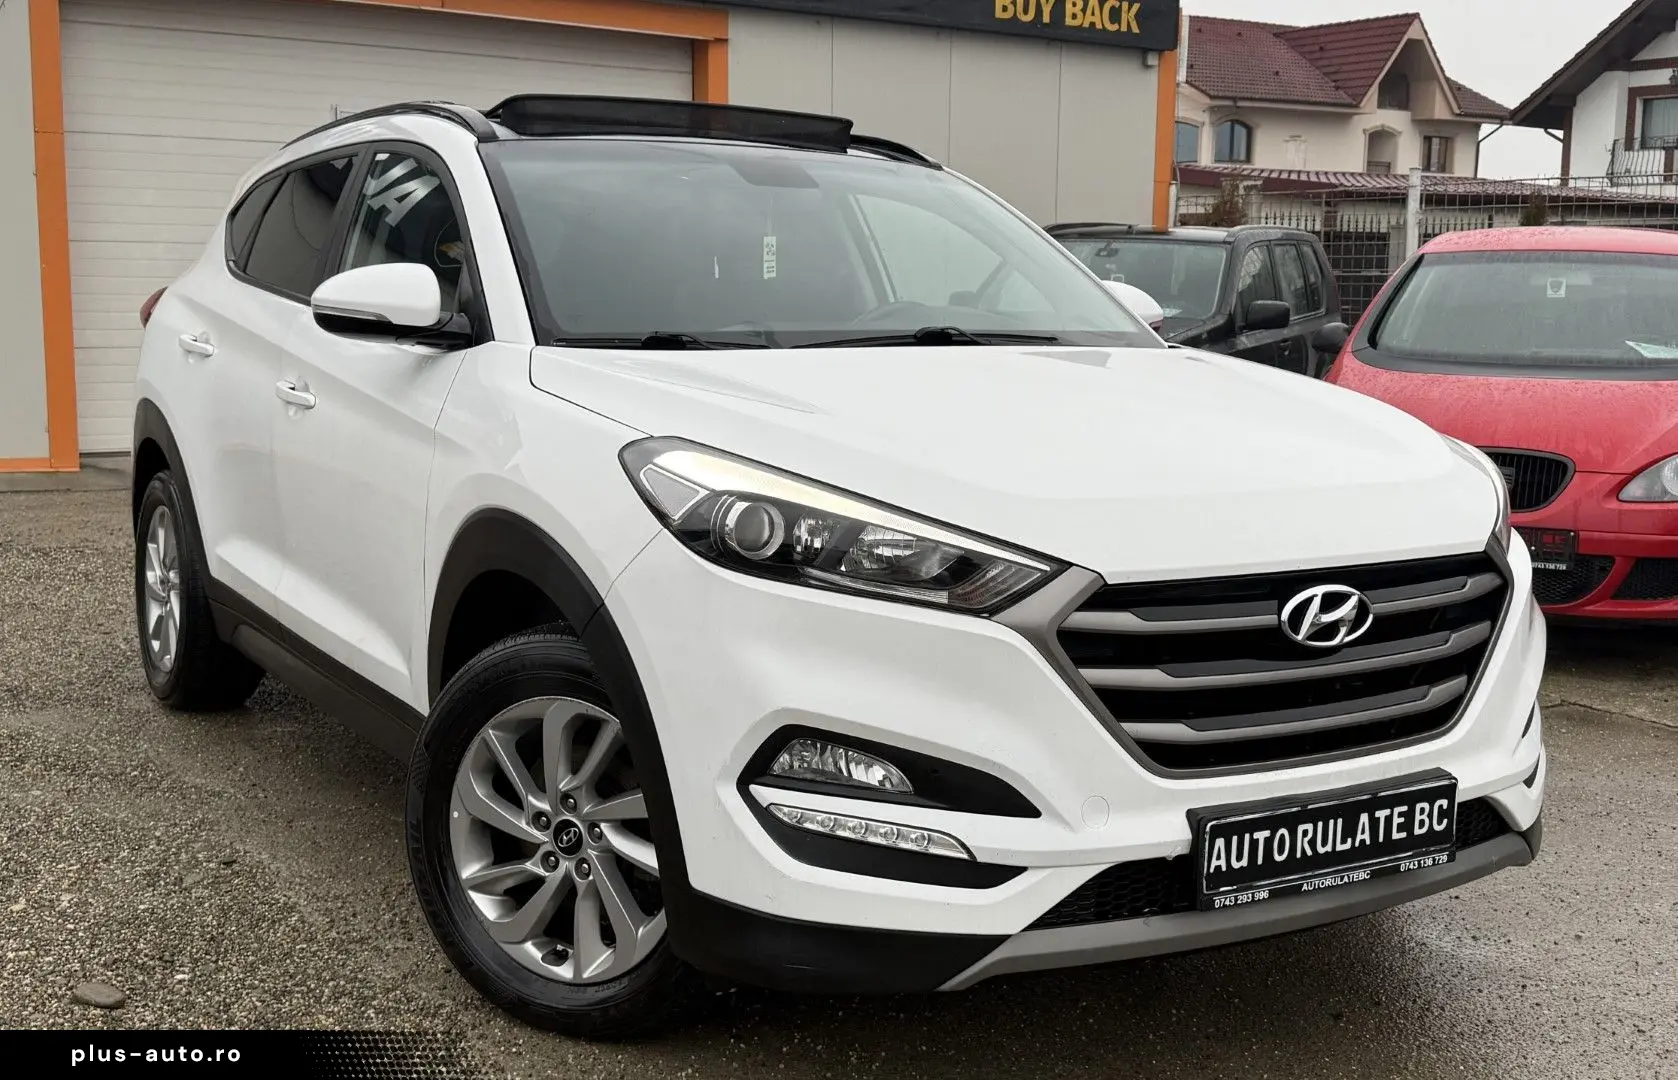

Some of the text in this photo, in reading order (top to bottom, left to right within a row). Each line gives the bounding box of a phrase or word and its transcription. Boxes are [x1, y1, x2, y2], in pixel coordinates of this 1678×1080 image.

[995, 0, 1141, 34] BUY BACK
[1209, 799, 1449, 874] AUTO RULATE BC
[1400, 855, 1448, 872] 0743 136 729
[1301, 871, 1371, 891] AUTORULATEBC
[1214, 890, 1270, 909] 0743 293 996
